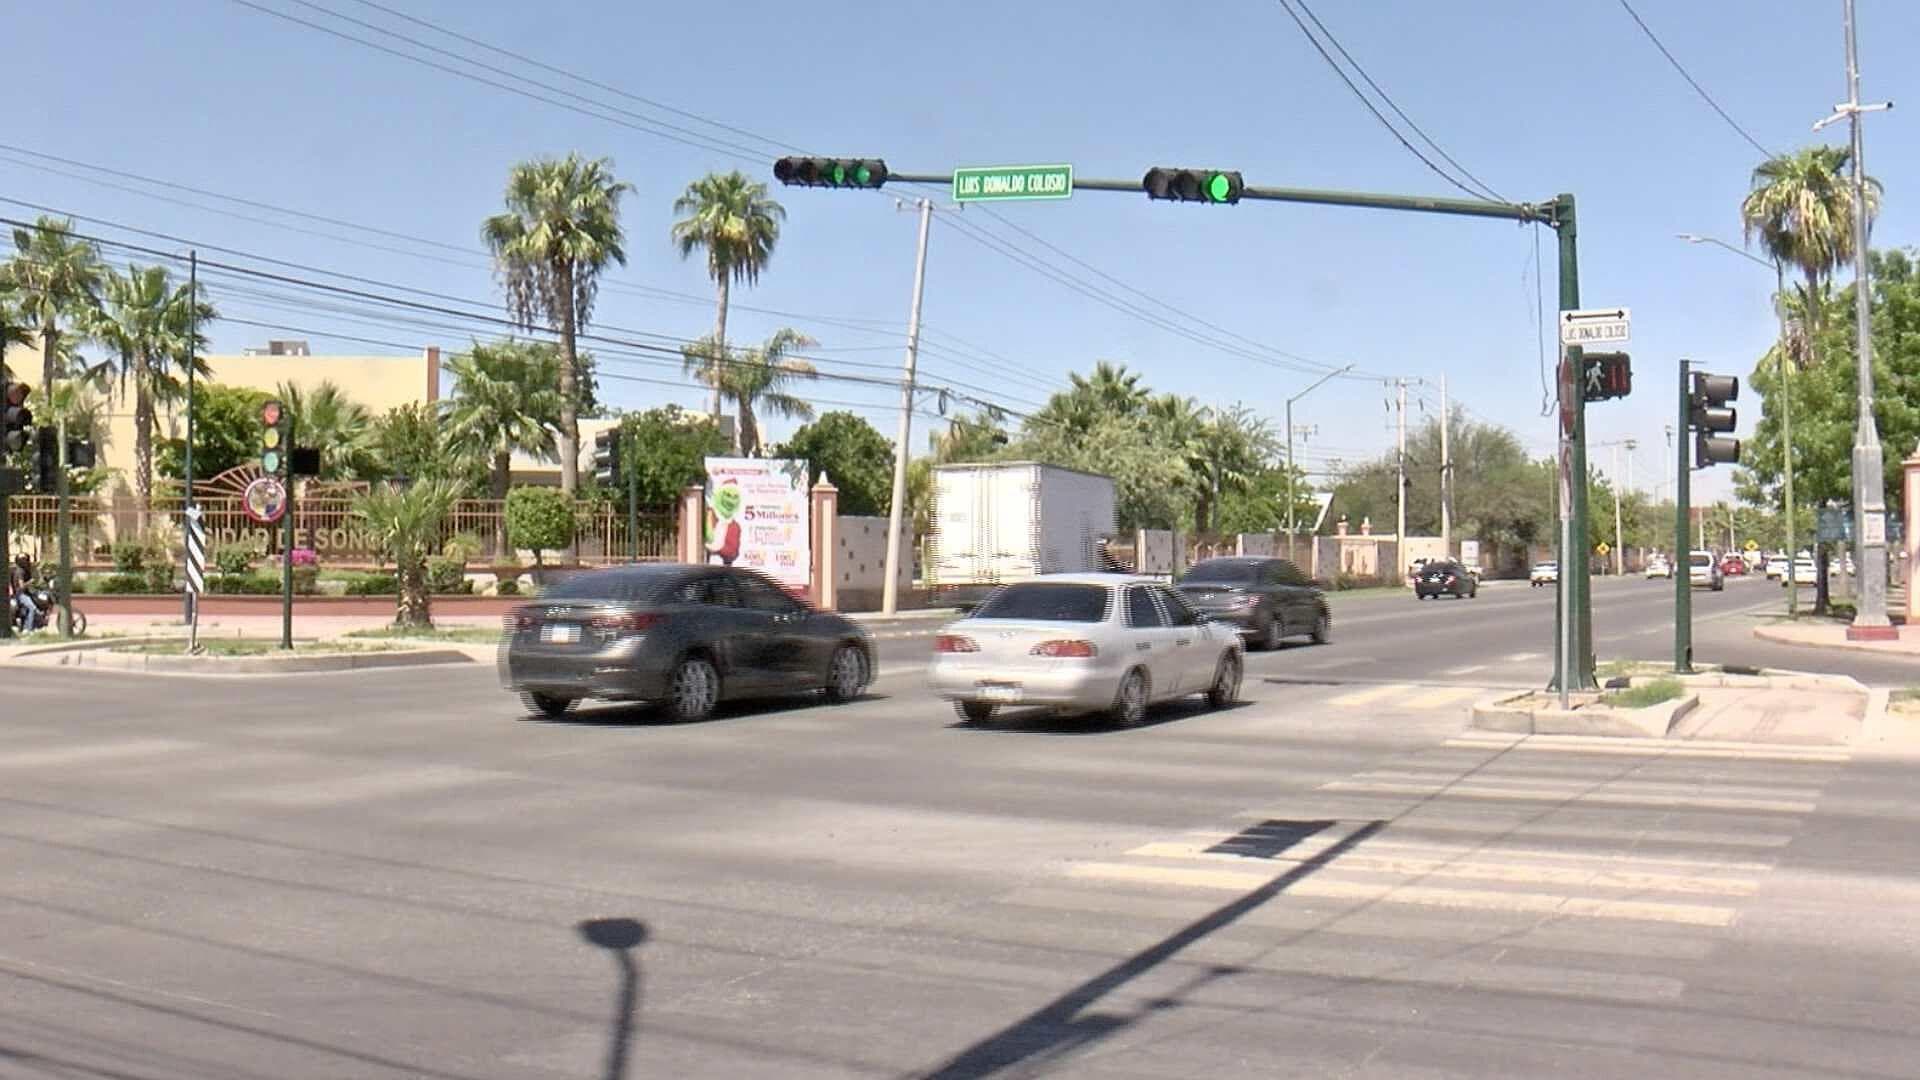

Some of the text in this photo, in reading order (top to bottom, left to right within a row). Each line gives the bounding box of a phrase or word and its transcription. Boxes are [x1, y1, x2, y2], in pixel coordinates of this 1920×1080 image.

[959, 173, 1066, 194] LUIS DONALDO COLOSIO
[744, 505, 755, 521] 5
